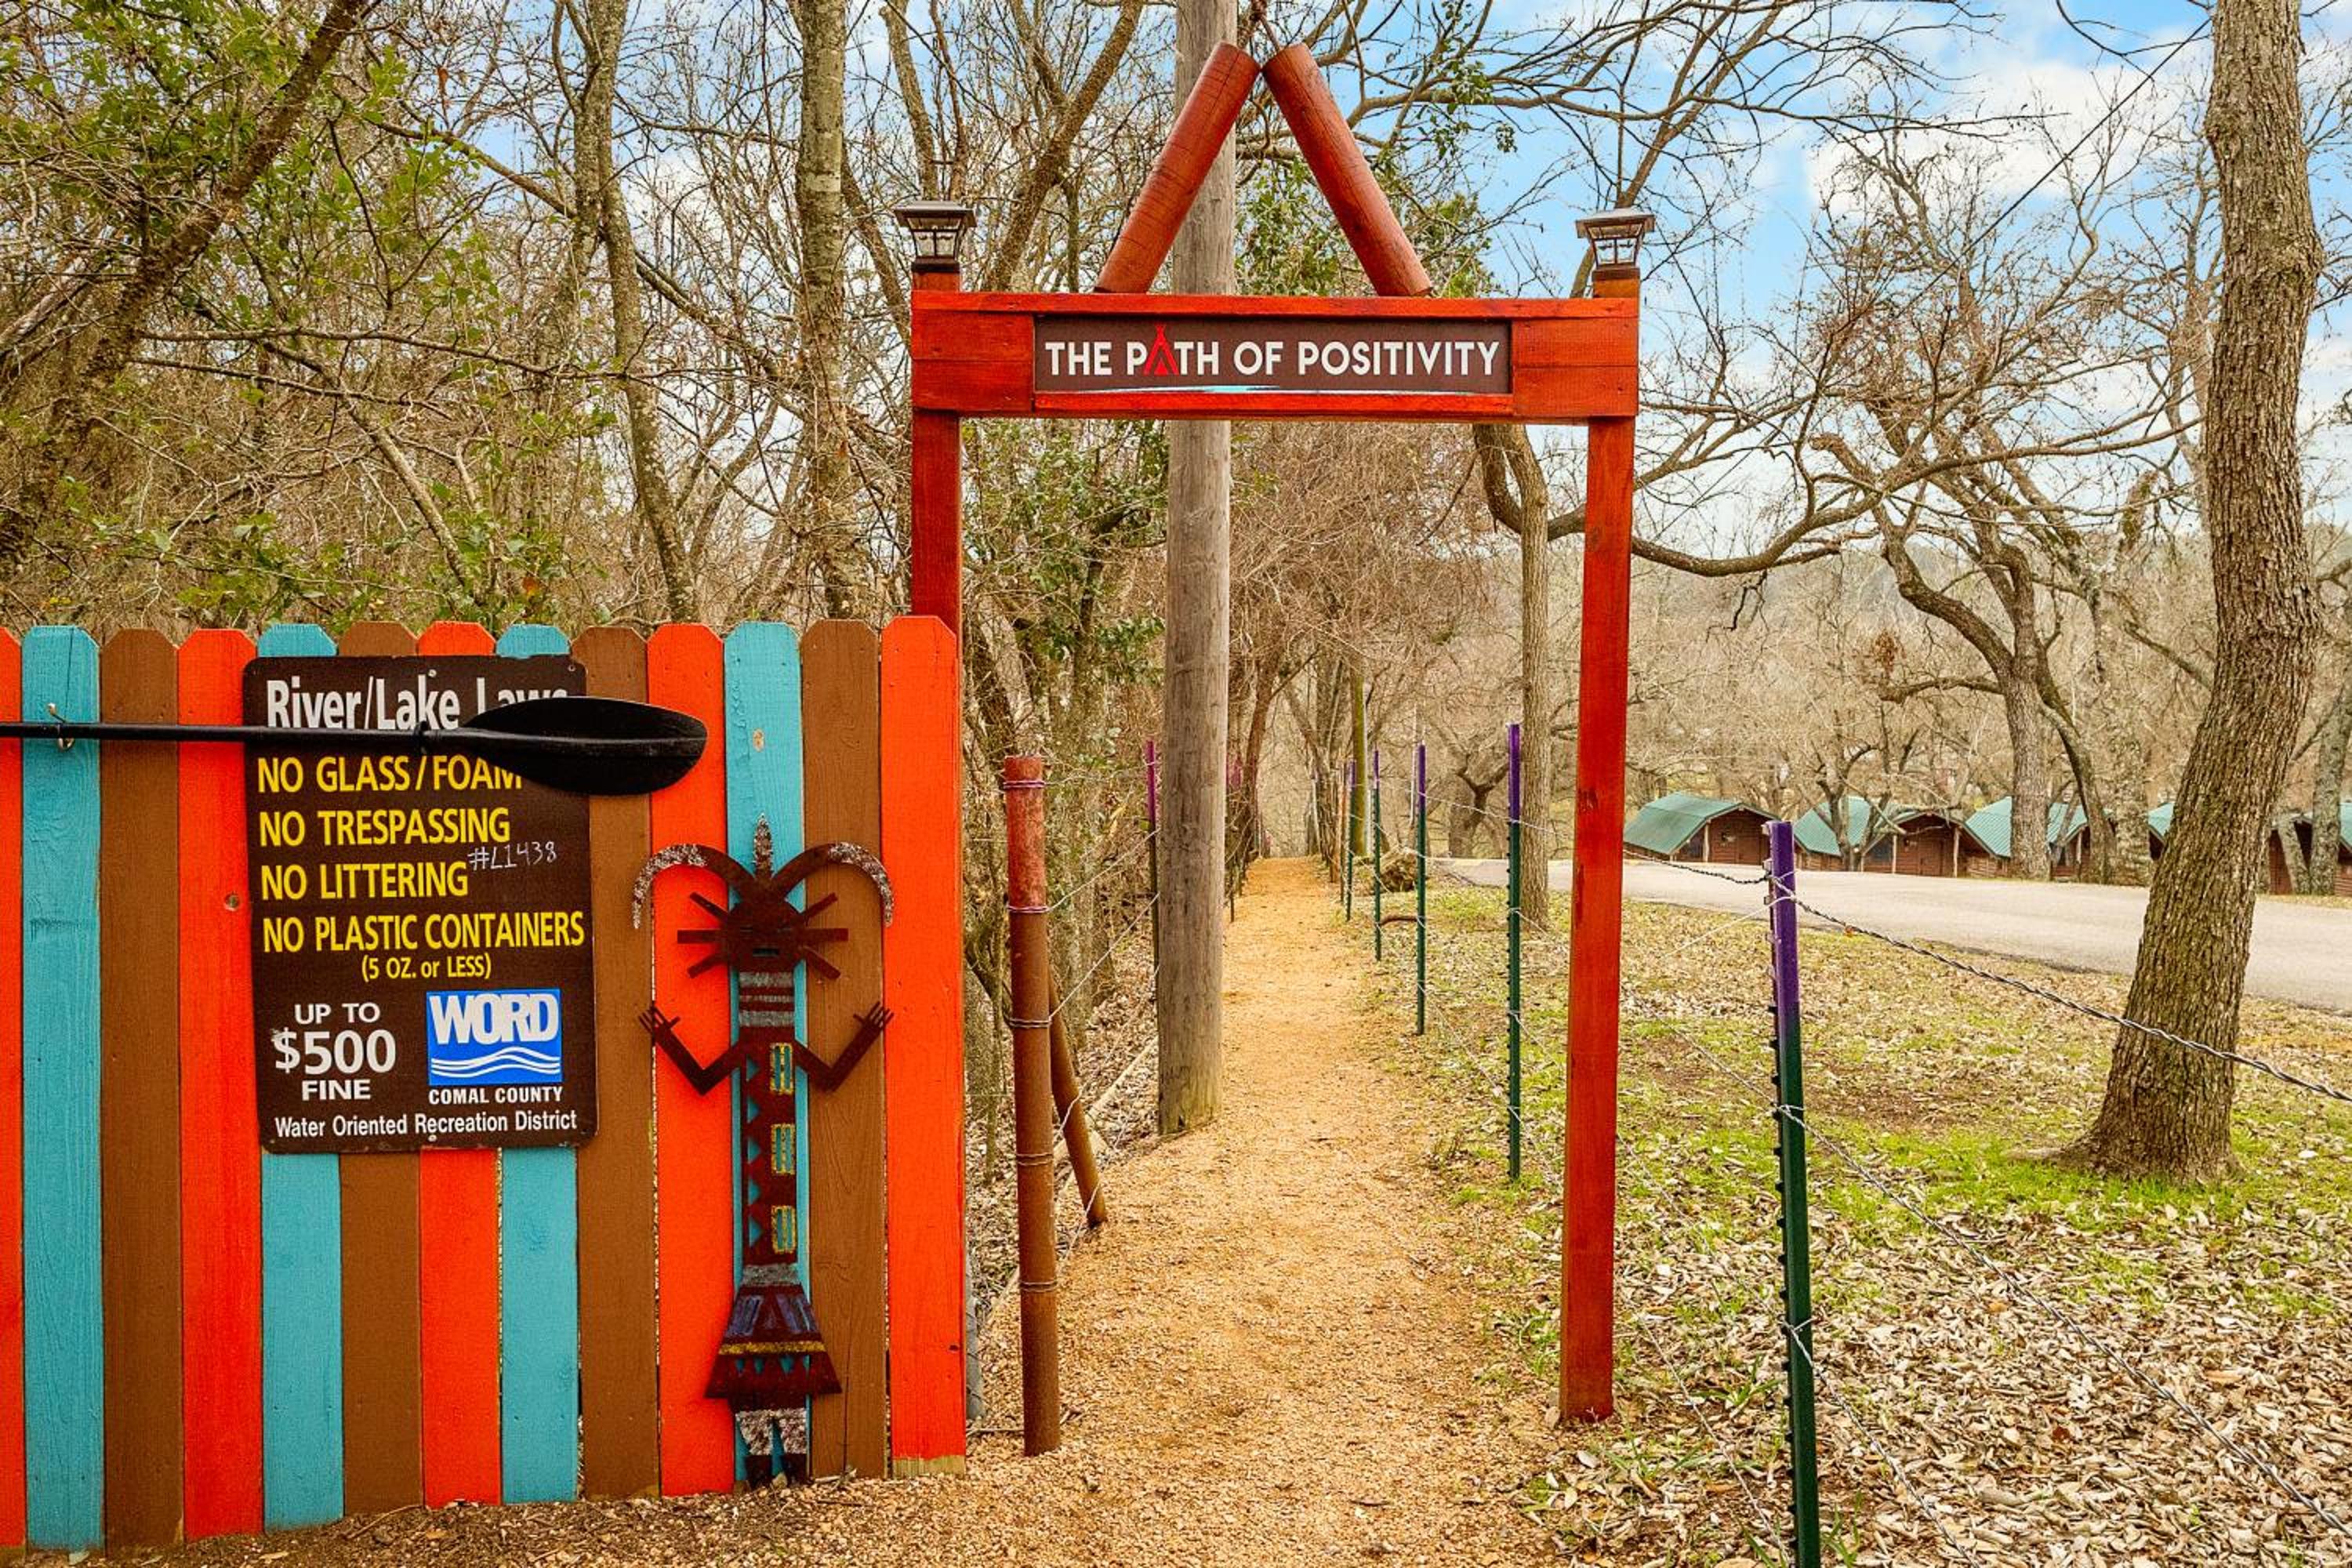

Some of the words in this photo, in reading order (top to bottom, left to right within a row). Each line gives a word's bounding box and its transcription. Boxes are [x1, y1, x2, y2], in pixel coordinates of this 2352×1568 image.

[1045, 342, 1112, 376] THE
[1127, 322, 1220, 376] PATH
[1233, 341, 1284, 376] OF
[1298, 341, 1499, 376] POSITIVITY
[258, 758, 304, 793] NO
[260, 811, 306, 847] NO
[318, 808, 510, 844] TRESPASSING
[262, 865, 307, 900] NO
[320, 861, 469, 898] LITTERING
[263, 917, 304, 953] NO
[316, 914, 418, 951] PLASTIC
[424, 911, 585, 948] CONTAINERS
[361, 954, 379, 982] (5
[387, 957, 417, 979] OZ.
[421, 960, 440, 978] or
[447, 953, 492, 979] LESS)
[294, 1004, 331, 1024] UP
[343, 1002, 380, 1023] TO
[429, 993, 558, 1045] WORD
[273, 1029, 397, 1075] $500
[302, 1079, 371, 1101] FINE
[429, 1087, 489, 1105] COMAL
[495, 1086, 563, 1104] COUNTY
[275, 1116, 325, 1138] Water
[332, 1112, 407, 1135] Oriented
[416, 1112, 507, 1134] Recreation
[516, 1109, 577, 1131] District
